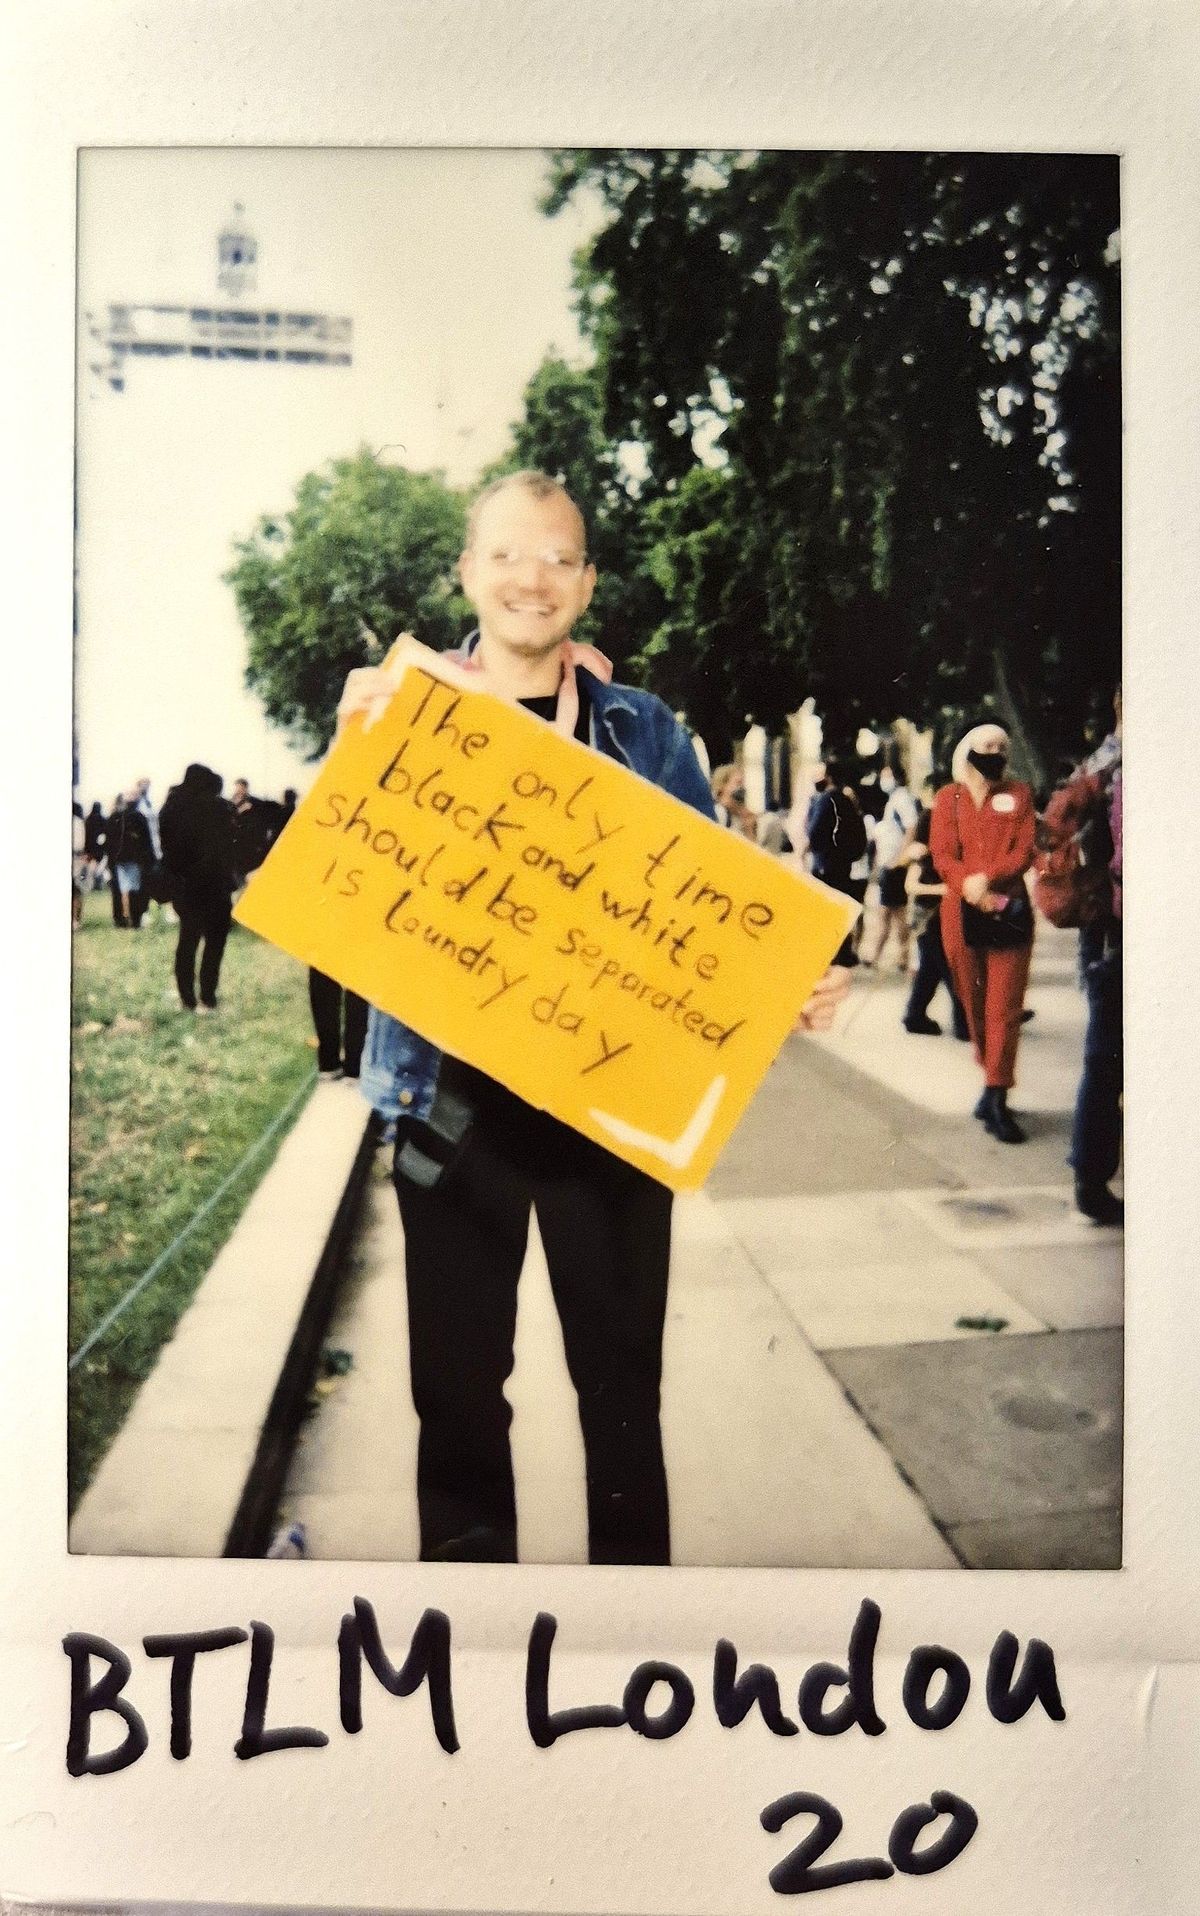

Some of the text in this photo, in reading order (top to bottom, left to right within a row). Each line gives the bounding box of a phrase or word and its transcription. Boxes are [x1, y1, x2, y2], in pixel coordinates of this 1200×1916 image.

[377, 741, 722, 981] black and white
[409, 668, 775, 941] The only time
[321, 857, 634, 1075] is laundry day
[493, 866, 538, 936] be
[556, 927, 747, 1049] separated
[62, 1597, 461, 1777] BTLM
[759, 1790, 979, 1894] 20
